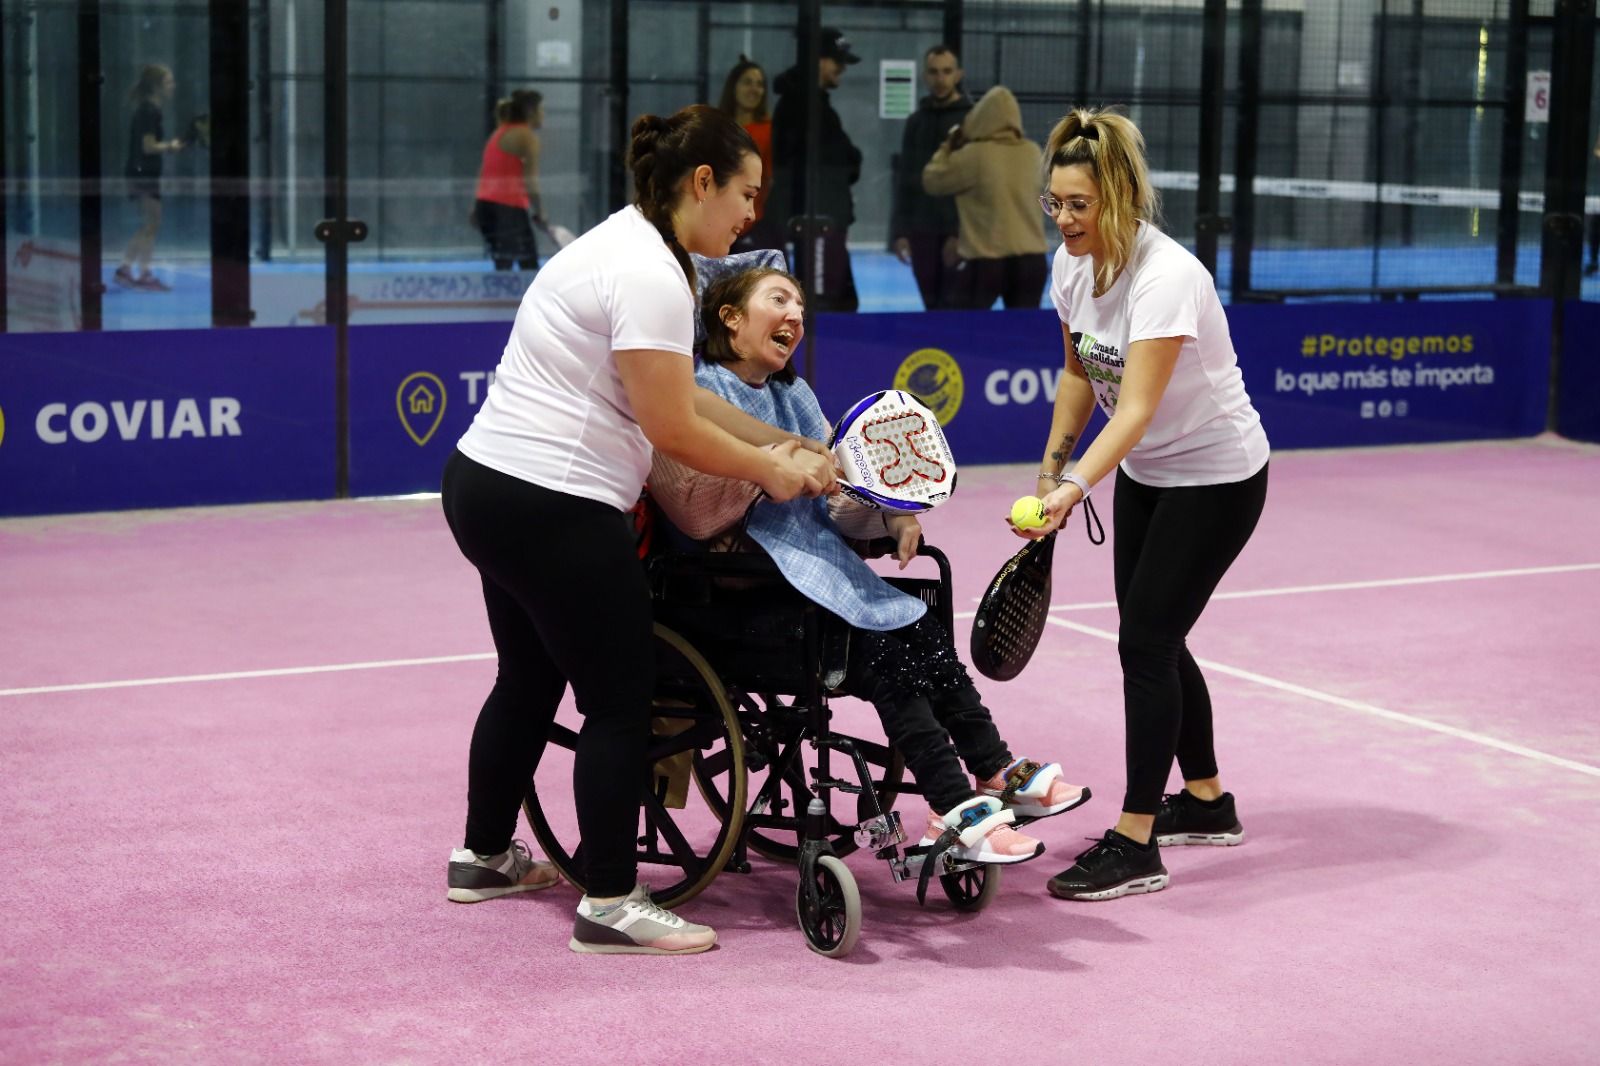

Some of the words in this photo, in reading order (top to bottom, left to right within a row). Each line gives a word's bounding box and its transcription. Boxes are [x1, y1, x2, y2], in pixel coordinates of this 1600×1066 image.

[1535, 88, 1548, 110] 6
[1089, 351, 1126, 368] solidari
[1301, 334, 1474, 360] #Protegemos
[984, 367, 1066, 406] COV
[1275, 367, 1295, 392] lo
[1298, 370, 1340, 396] que
[1343, 364, 1388, 389] más
[1390, 366, 1412, 387] te
[1414, 361, 1494, 391] importa
[35, 396, 242, 445] COVIAR
